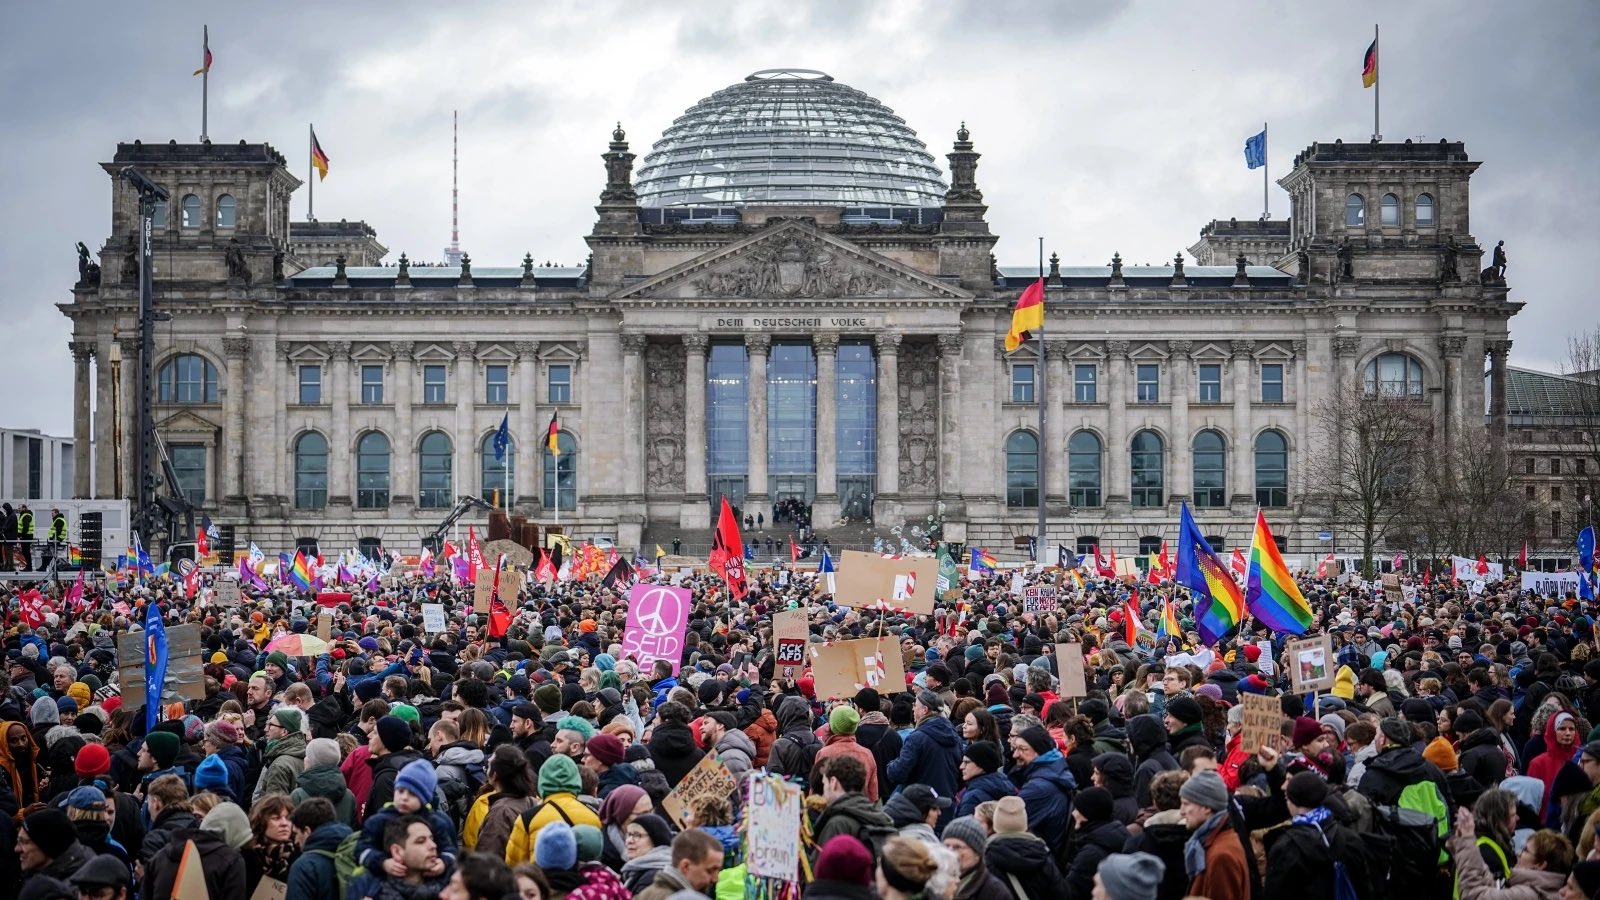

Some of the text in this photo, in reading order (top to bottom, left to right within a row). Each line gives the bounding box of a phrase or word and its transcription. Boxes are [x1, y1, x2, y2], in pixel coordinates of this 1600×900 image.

[717, 318, 867, 327] DEM DEUTSCHEN VOLKE
[1535, 577, 1559, 595] BJÖRN
[1025, 588, 1039, 597] KEIN
[1039, 596, 1056, 605] NAZIS
[624, 631, 678, 656] SEID
[779, 643, 804, 653] FCK
[778, 652, 802, 662] AFD
[1245, 694, 1280, 714] EGAL WIE
[677, 776, 694, 797] SOGAR
